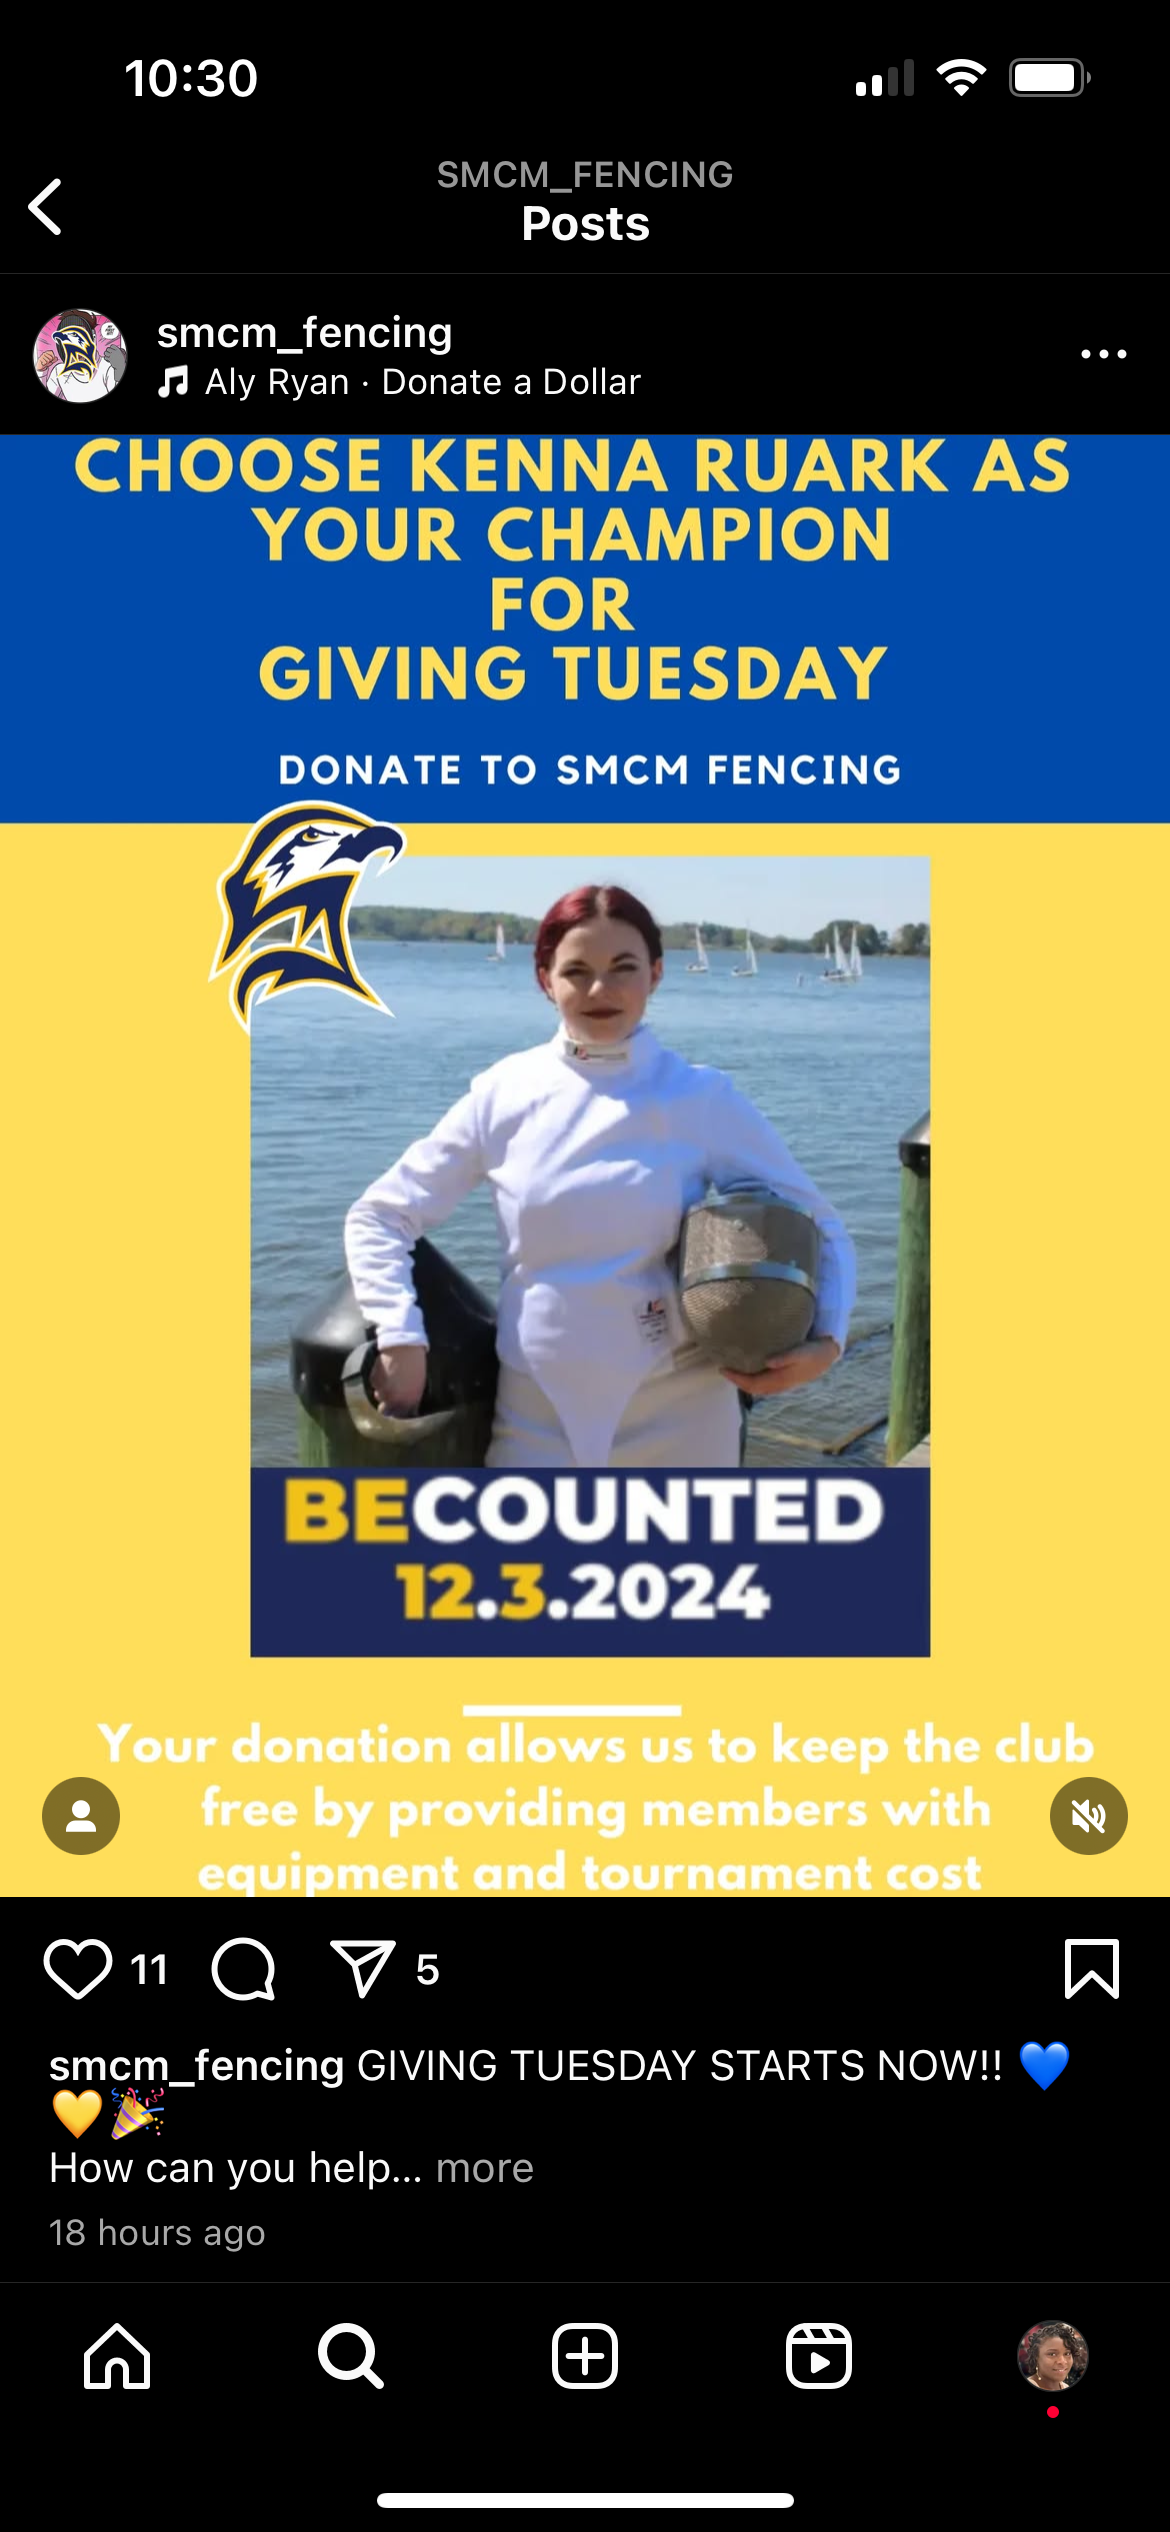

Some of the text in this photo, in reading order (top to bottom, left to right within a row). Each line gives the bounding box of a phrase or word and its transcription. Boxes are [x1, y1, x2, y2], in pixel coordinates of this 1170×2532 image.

[126, 59, 257, 97] 10:30
[438, 161, 732, 193] SMCM_FENCING
[524, 206, 649, 241] Posts
[158, 315, 451, 355] smcm_fencing
[205, 367, 641, 401] Aly Ryan Donate a Dollar
[75, 438, 1069, 492] CHOOSE KENNA RUARK AS
[251, 507, 888, 561] YOUR CHAMPION
[492, 577, 634, 631] FOR
[260, 646, 887, 700] GIVING TUESDAY
[280, 755, 899, 784] DONATE TO SMCM FENCING
[396, 1563, 770, 1619] 12.3.2024
[98, 1722, 1093, 1772] Your donation allows us to keep the club
[202, 1785, 990, 1836] free by providing members with
[199, 1849, 981, 1897] equipment and tournament cost
[131, 1954, 166, 1985] 11
[417, 1954, 439, 1985] 5
[50, 2048, 1002, 2086] smcm_fencing GIVING TUESDAY STARTS NOW!!
[50, 2152, 133, 2183] How
[147, 2159, 213, 2183] can
[227, 2159, 295, 2191] you
[438, 2159, 533, 2183] more
[50, 2218, 264, 2253] 18 hours ago
